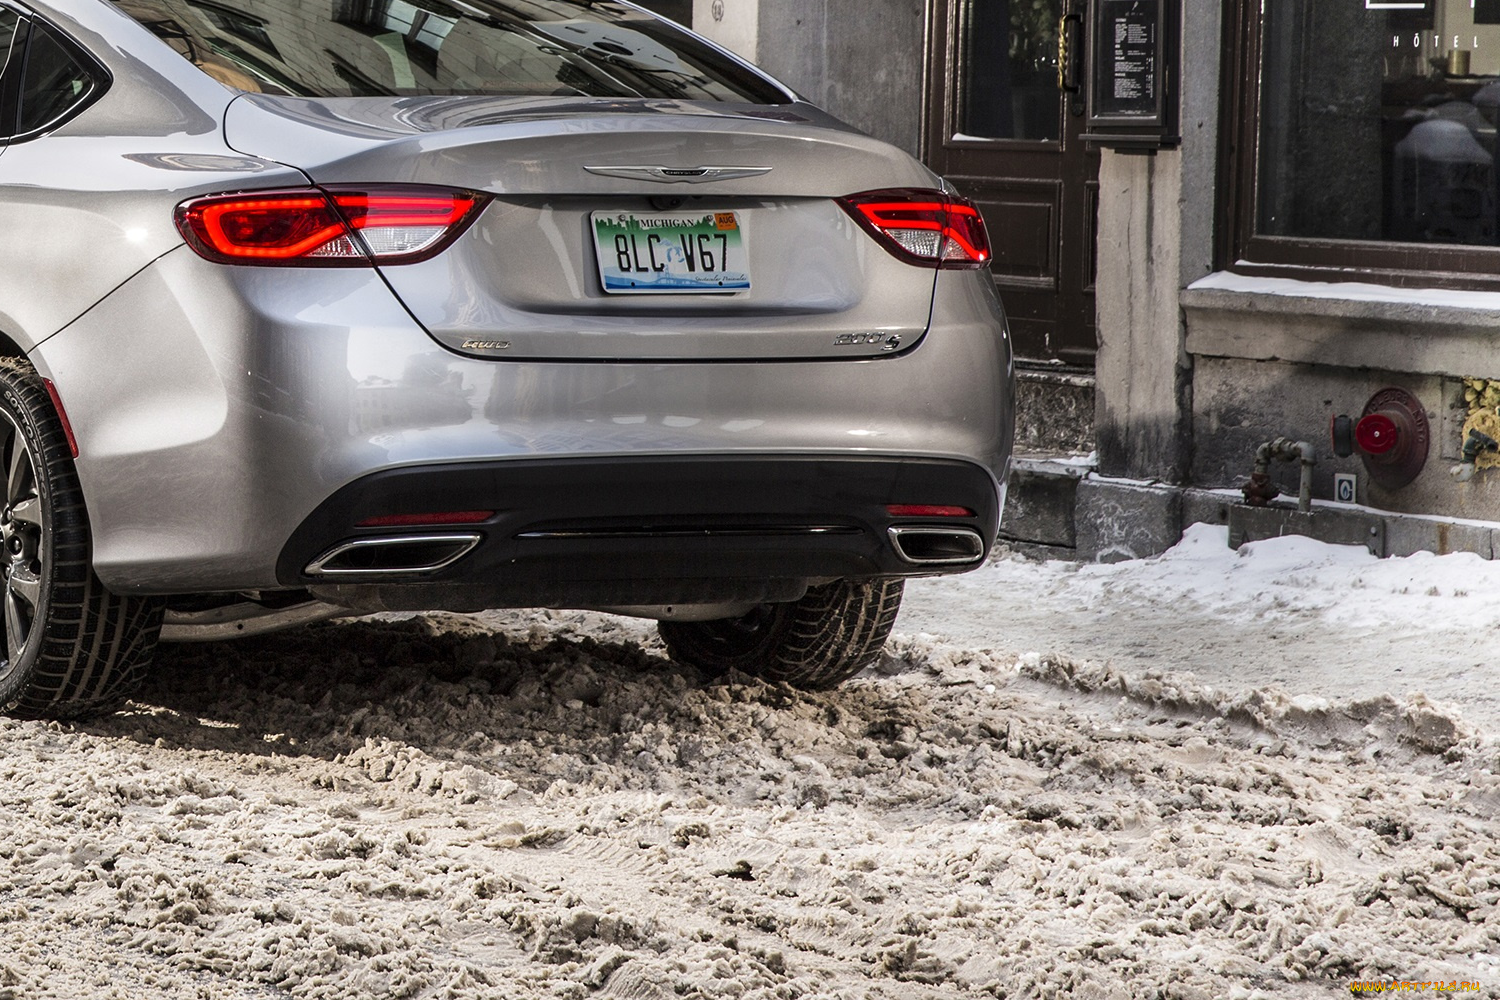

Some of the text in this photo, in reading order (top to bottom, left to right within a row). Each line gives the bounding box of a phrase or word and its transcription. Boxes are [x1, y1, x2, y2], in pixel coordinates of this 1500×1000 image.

[1393, 33, 1478, 47] HÔTEL
[640, 218, 694, 228] MICHIGAN
[718, 215, 734, 224] AUG
[614, 233, 728, 272] 8LC V67
